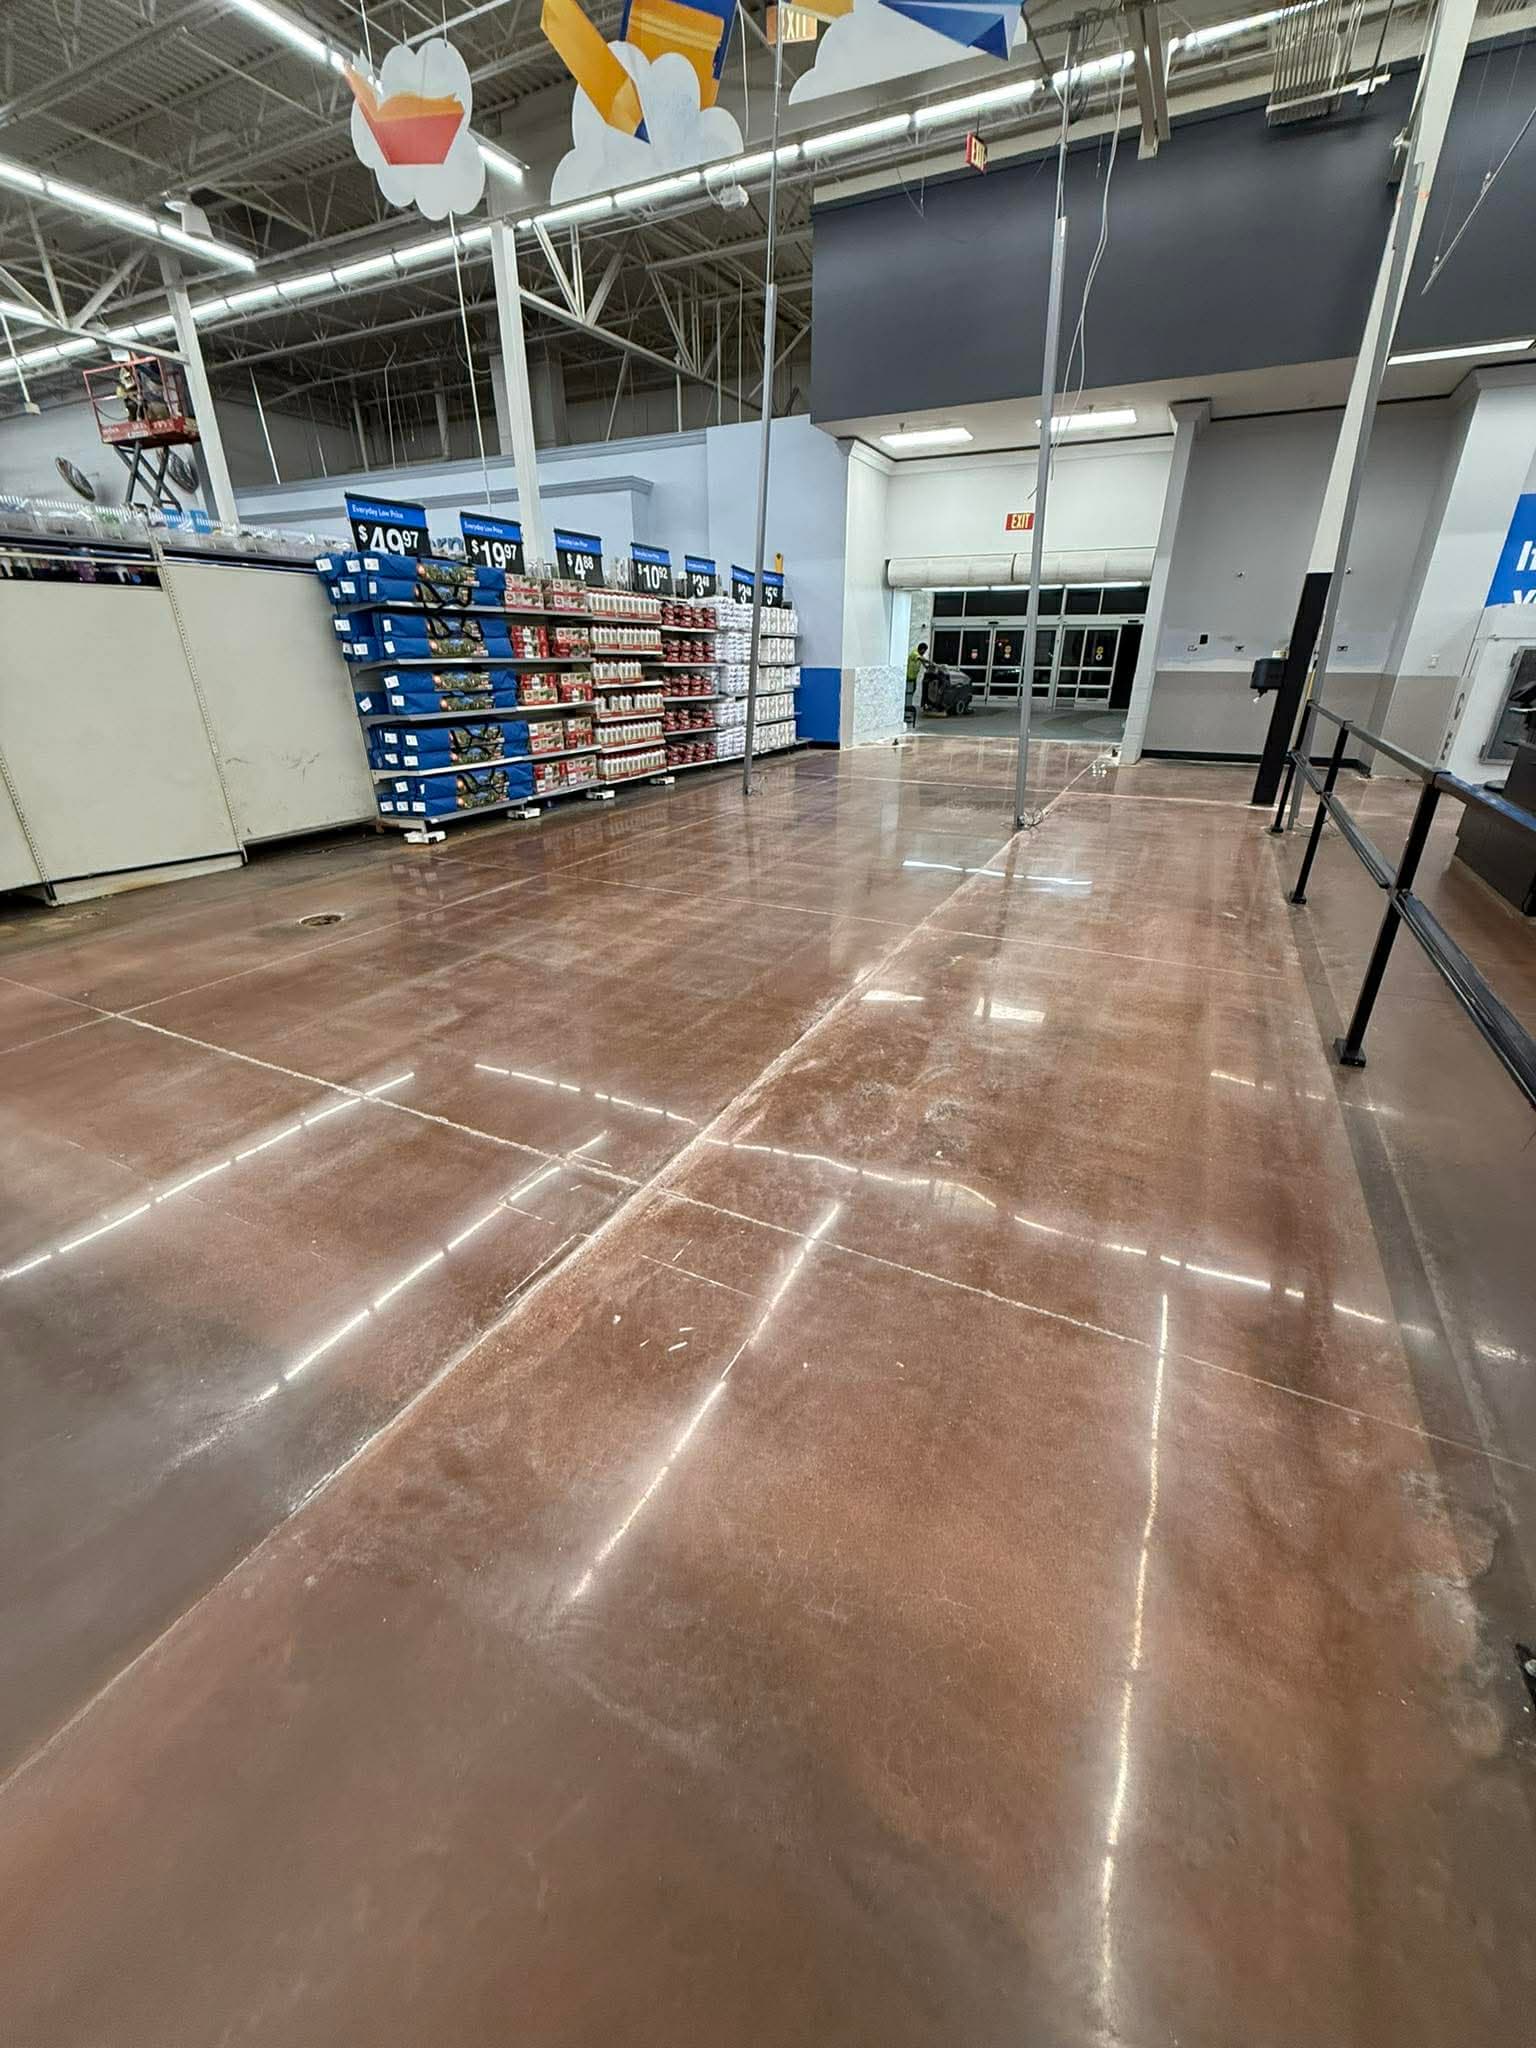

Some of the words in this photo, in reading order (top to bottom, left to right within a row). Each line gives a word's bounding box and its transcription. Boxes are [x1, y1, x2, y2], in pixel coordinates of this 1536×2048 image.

[352, 504, 378, 517] Everyday
[378, 508, 390, 517] Low
[391, 510, 404, 519] Price
[1011, 513, 1030, 529] EXIT
